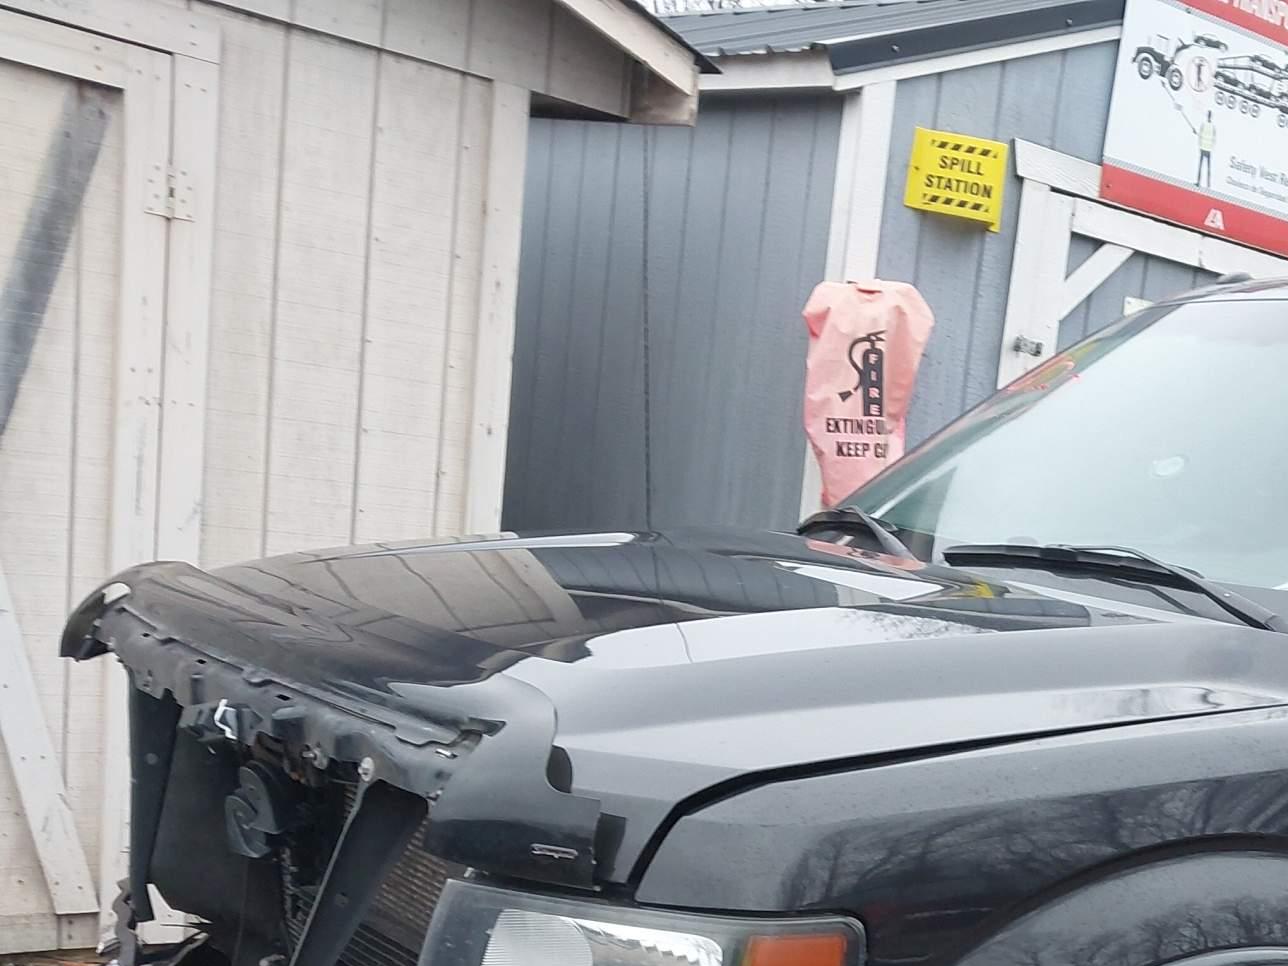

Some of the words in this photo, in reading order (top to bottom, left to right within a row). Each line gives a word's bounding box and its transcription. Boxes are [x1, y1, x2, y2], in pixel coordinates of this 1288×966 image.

[939, 155, 984, 176] SPILL
[924, 174, 993, 199] STATION
[868, 352, 882, 416] FIRE
[826, 417, 893, 435] EXTINGU
[836, 441, 870, 458] KEEP
